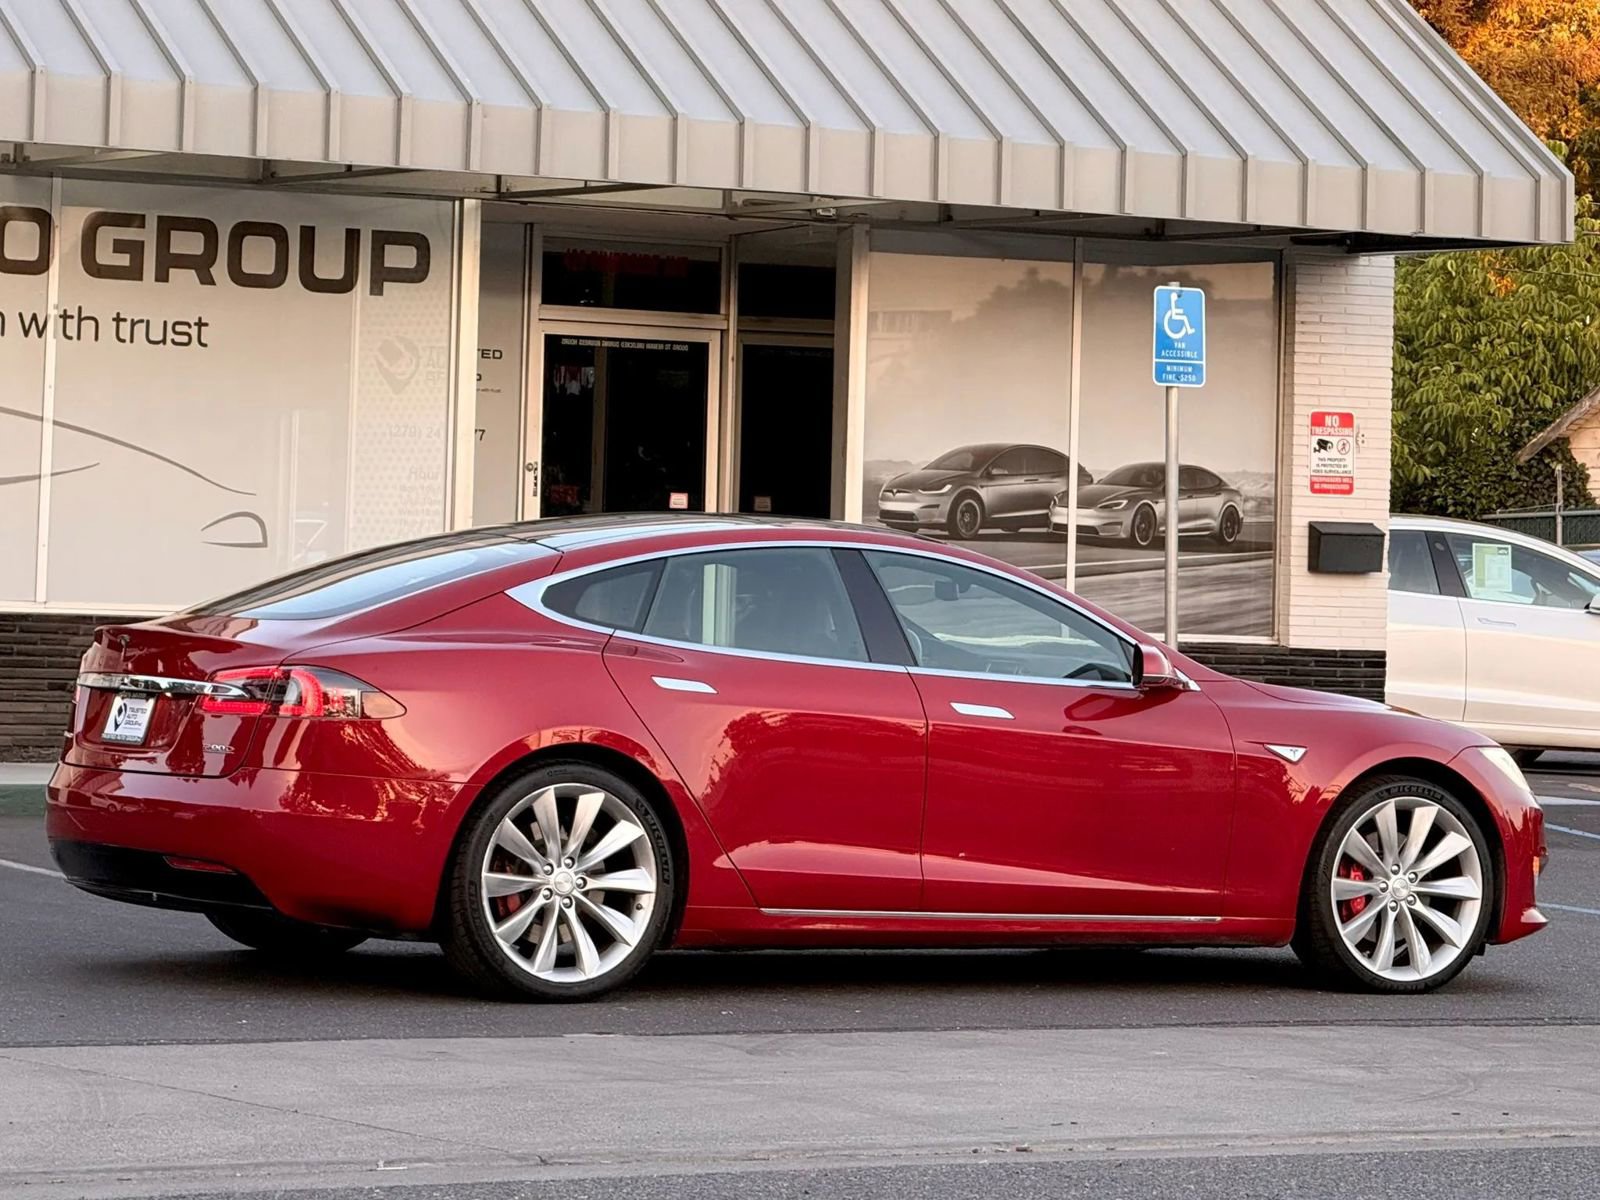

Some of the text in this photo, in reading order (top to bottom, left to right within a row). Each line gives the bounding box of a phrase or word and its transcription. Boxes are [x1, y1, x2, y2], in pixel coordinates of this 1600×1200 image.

[81, 211, 431, 297] GROUP
[112, 312, 210, 348] trust
[1161, 350, 1198, 358] ACCESSIBLE
[1166, 365, 1193, 373] MINIMUM
[1162, 373, 1177, 381] FINE
[1325, 415, 1340, 428] NO
[1311, 427, 1353, 436] TRESPASSING
[1389, 785, 1443, 800] MICHELIN
[646, 813, 671, 886] MICHELIN
